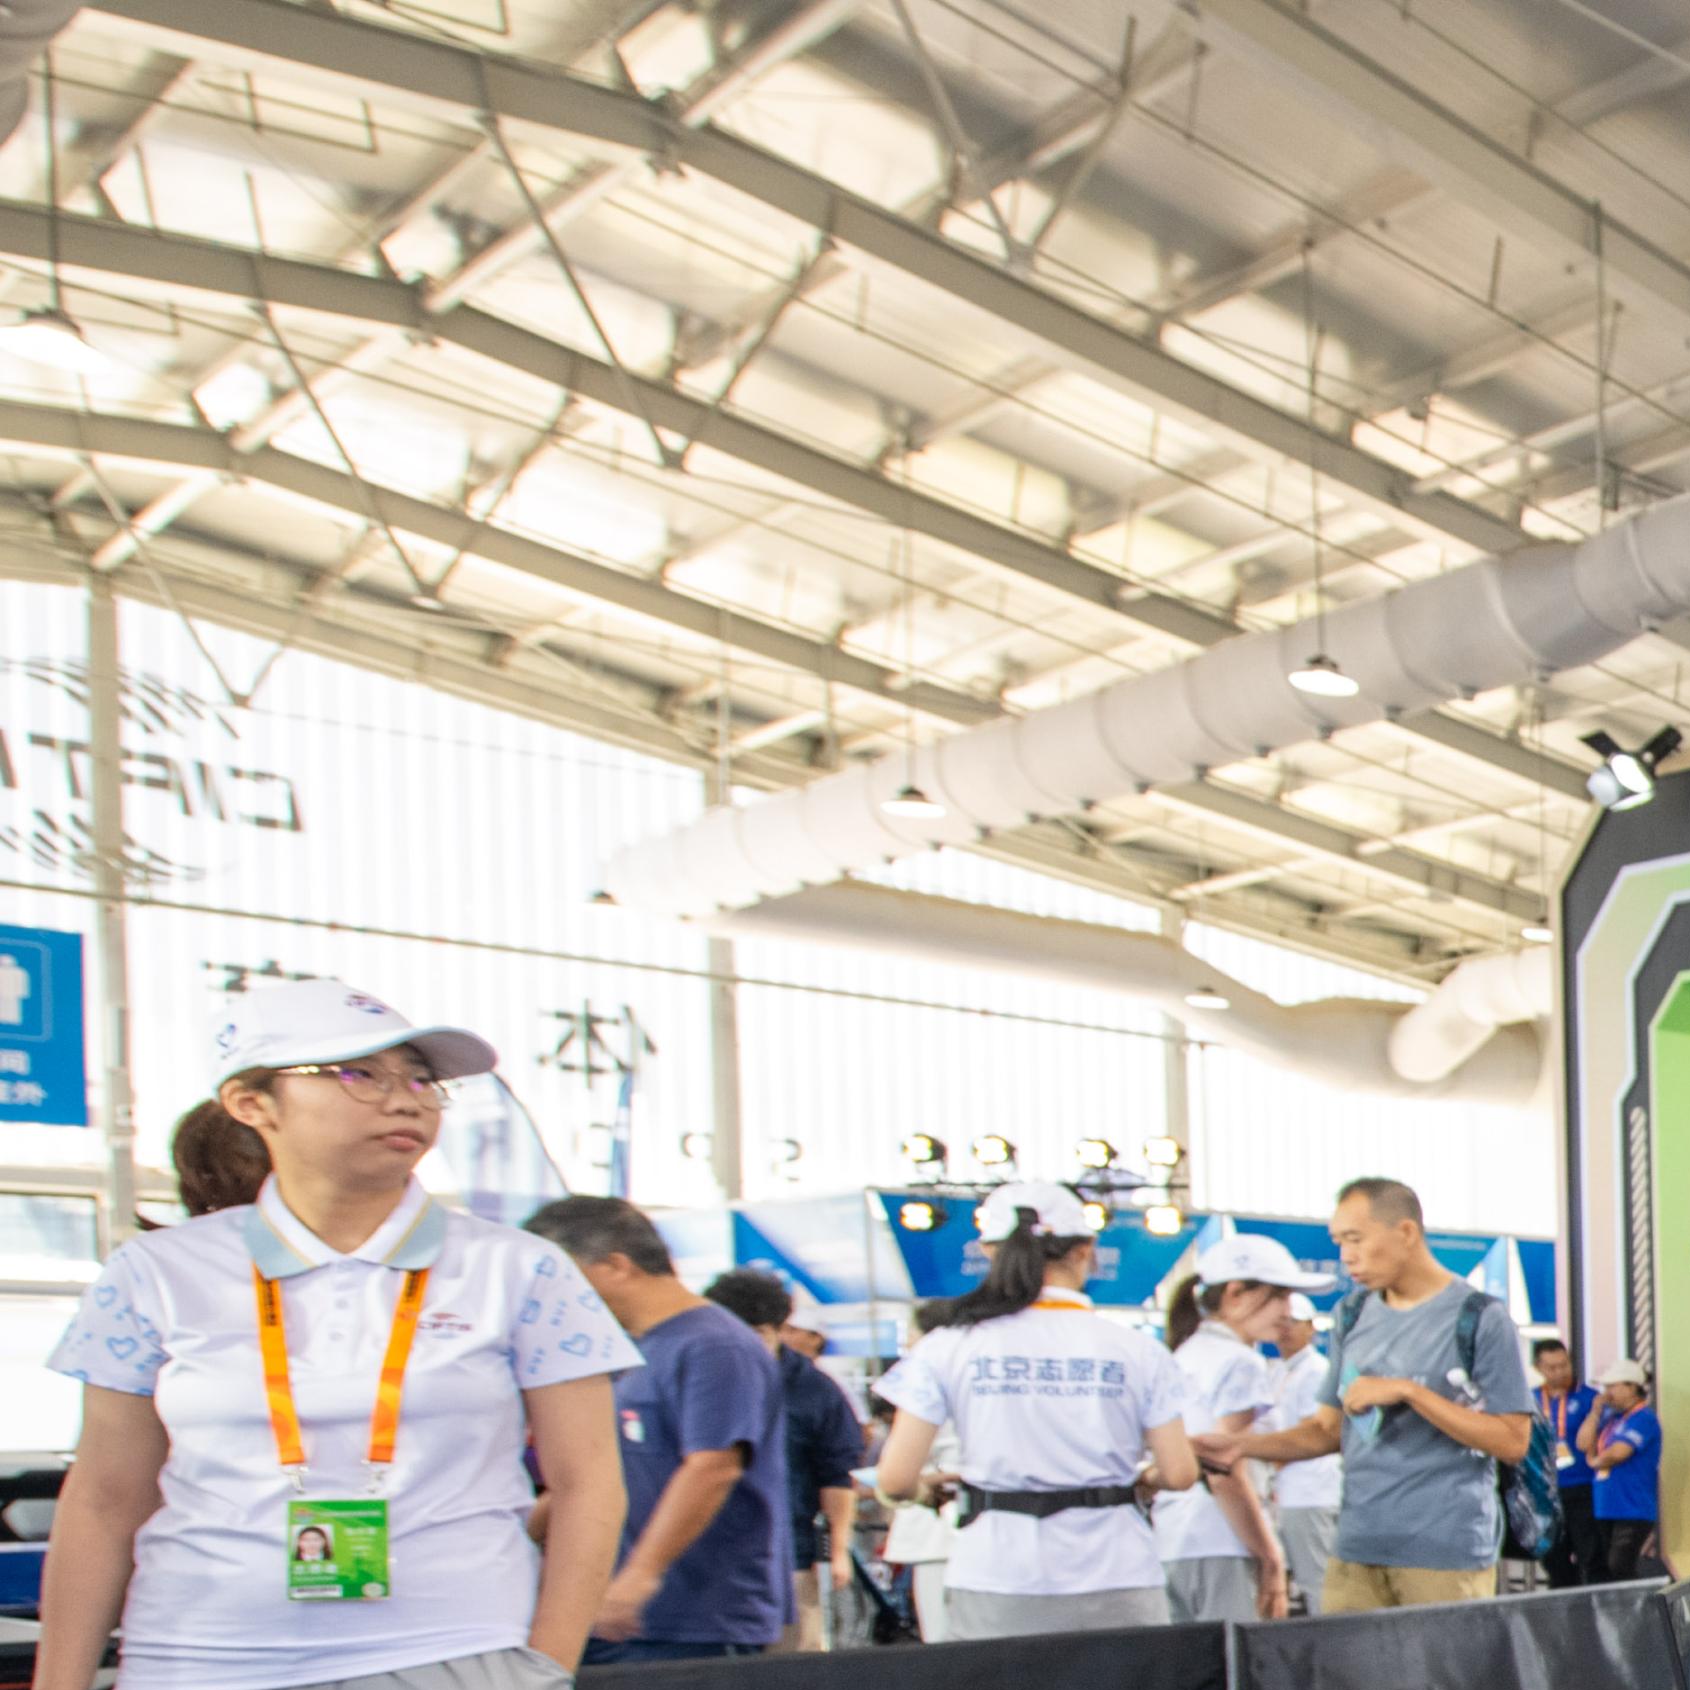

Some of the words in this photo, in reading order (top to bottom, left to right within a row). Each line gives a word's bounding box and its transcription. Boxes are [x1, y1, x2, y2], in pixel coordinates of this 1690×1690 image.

[969, 1356, 1125, 1385] 北京志愿者
[1034, 1385, 1125, 1399] VOLUNTEER
